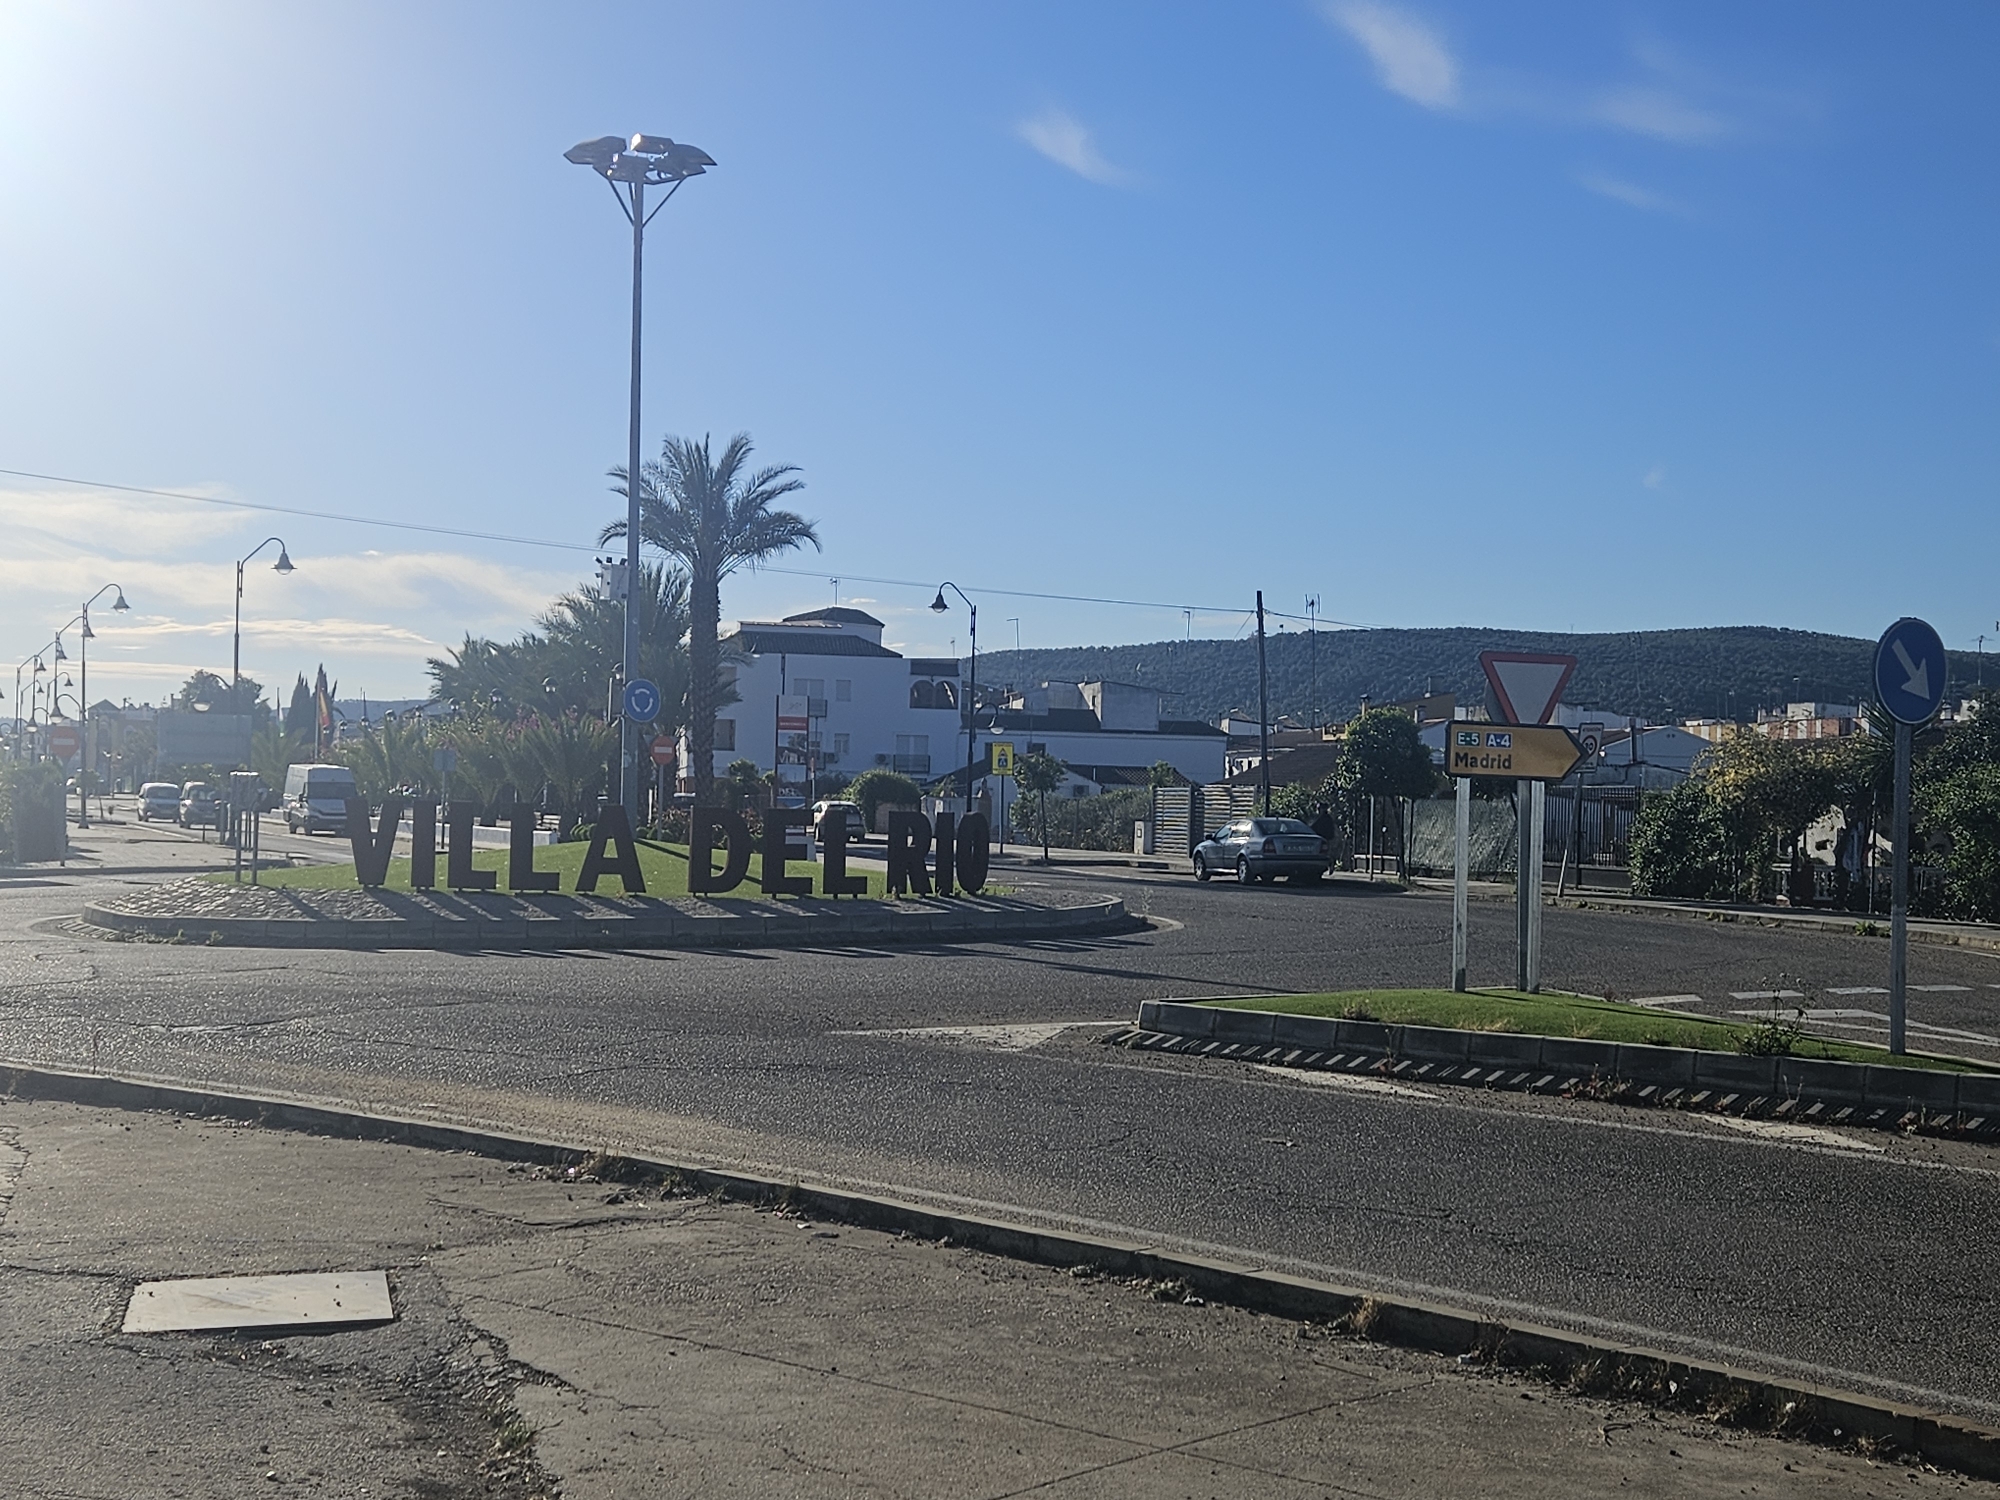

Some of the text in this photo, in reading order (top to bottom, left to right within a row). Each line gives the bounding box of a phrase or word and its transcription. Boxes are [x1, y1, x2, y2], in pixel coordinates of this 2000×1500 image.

[1457, 732, 1510, 747] E-5 A-4
[1455, 751, 1512, 769] Madrid
[345, 799, 990, 896] VILLA DEL RIO
